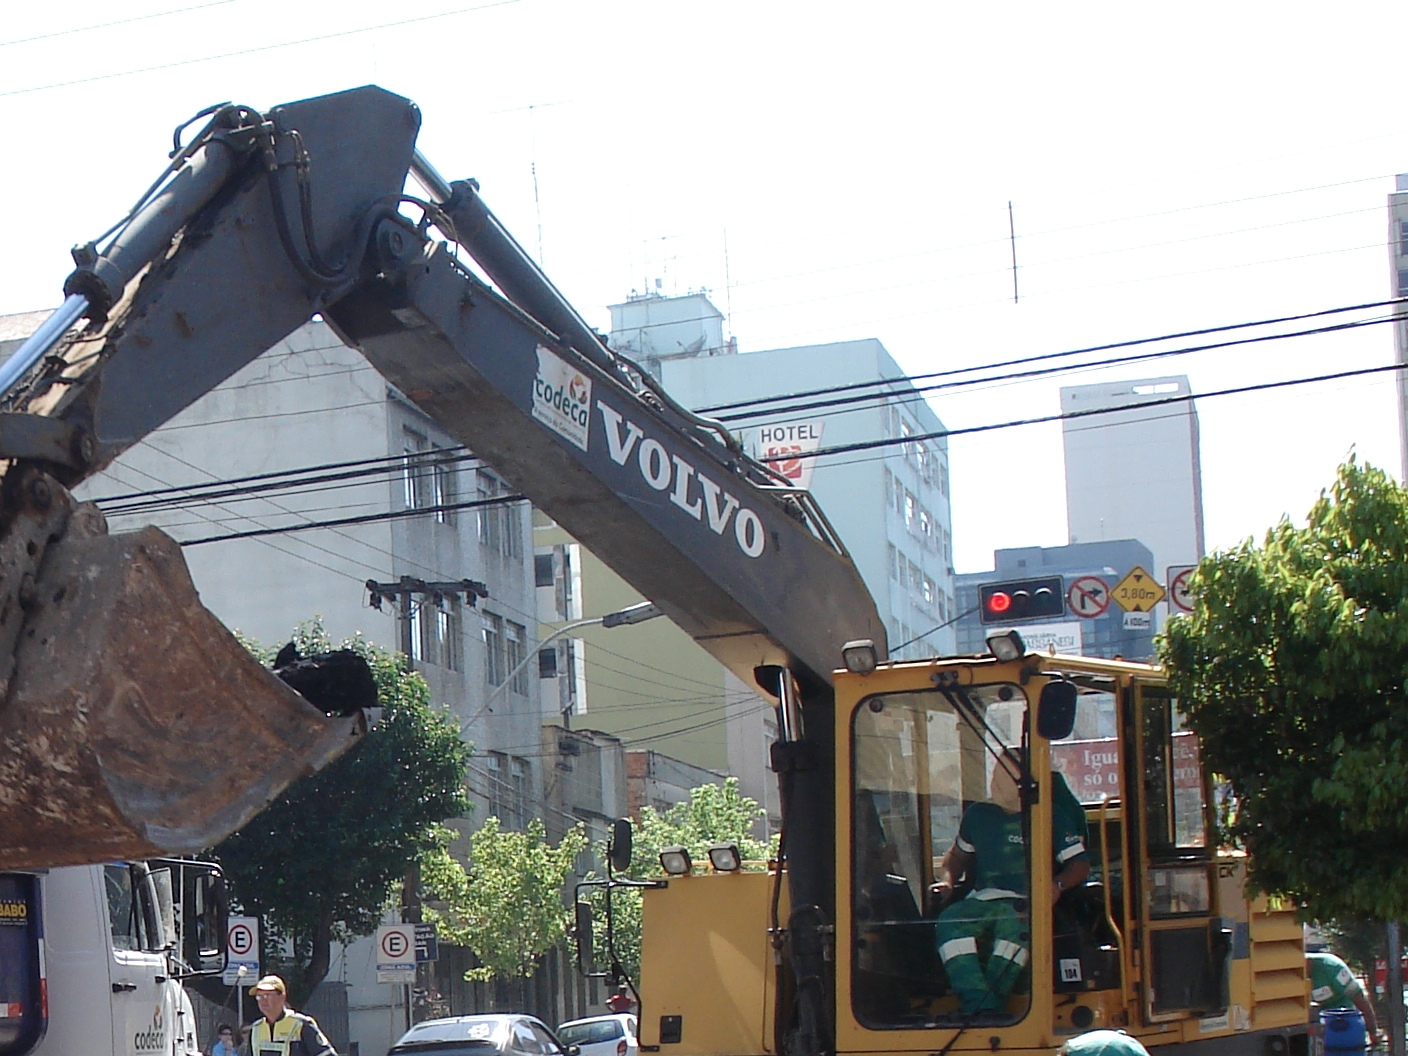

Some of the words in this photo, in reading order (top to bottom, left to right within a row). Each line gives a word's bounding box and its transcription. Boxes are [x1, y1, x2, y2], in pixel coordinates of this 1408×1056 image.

[536, 378, 588, 427] codeca
[761, 425, 819, 443] HOTEL
[597, 400, 765, 558] VOLVO
[1121, 587, 1155, 600] 3,80m
[1084, 769, 1102, 786] só
[235, 931, 246, 948] E
[390, 937, 401, 952] E
[134, 1024, 164, 1050] codeca
